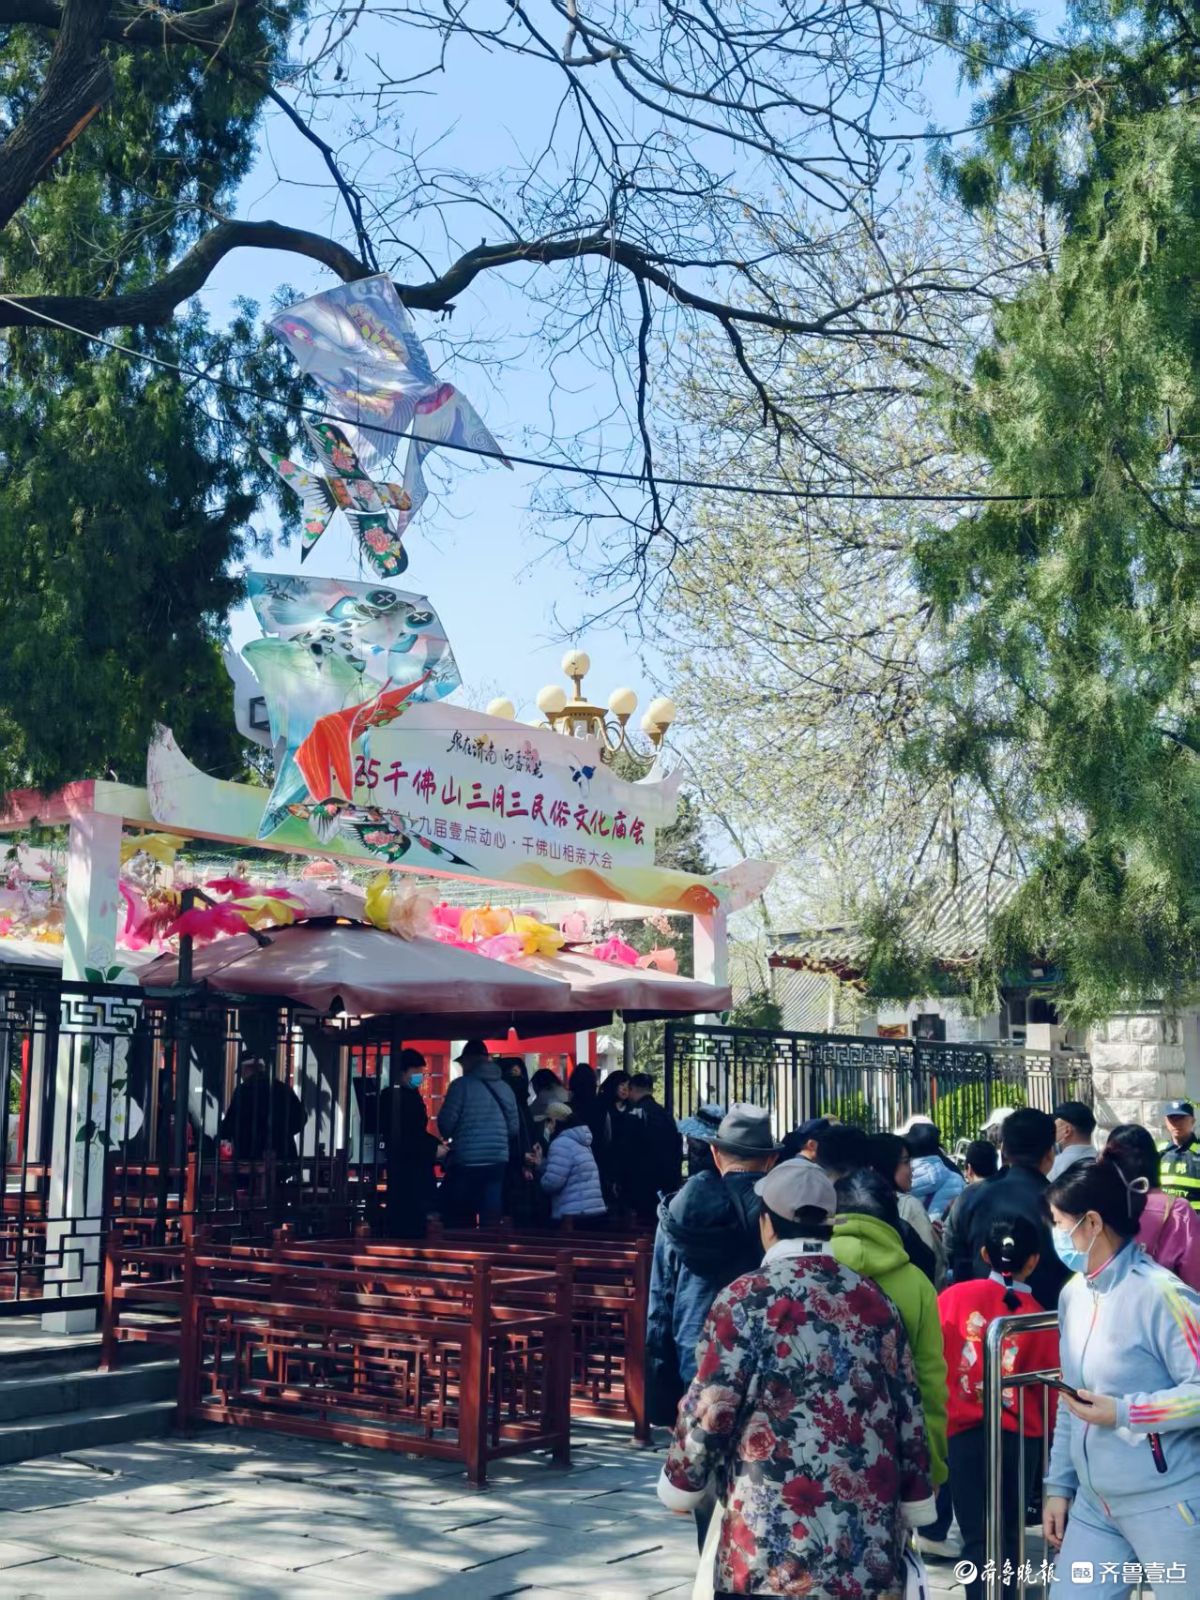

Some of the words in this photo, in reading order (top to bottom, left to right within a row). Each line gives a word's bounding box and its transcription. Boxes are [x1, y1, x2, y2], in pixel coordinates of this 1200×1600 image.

[354, 754, 646, 846] 25千佛山三月三民俗文化庙会
[386, 808, 613, 870] 九届壹点动心·千佛山相亲大会
